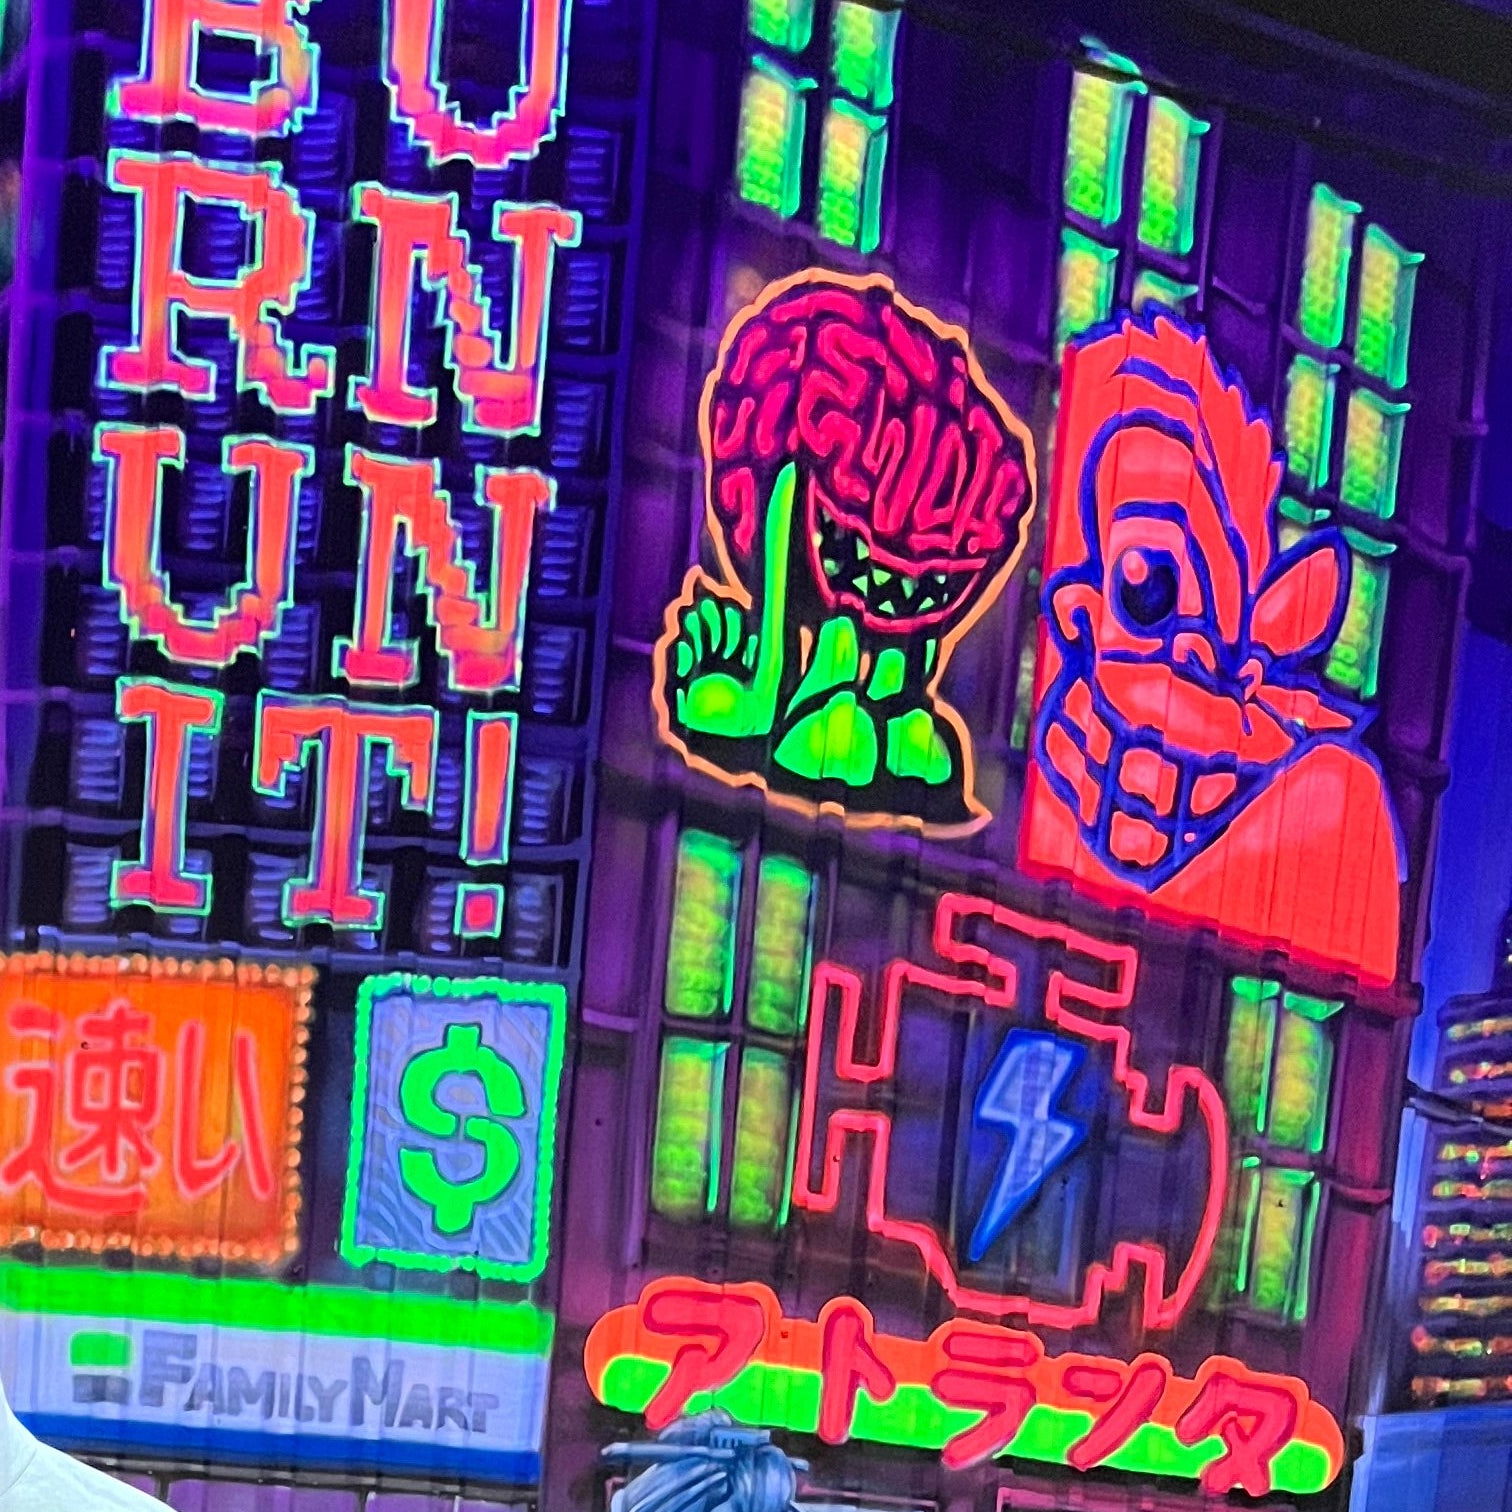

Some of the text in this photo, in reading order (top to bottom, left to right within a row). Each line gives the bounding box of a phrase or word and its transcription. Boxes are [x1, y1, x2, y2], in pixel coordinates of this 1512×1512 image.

[639, 1281, 1300, 1497] アトランタ
